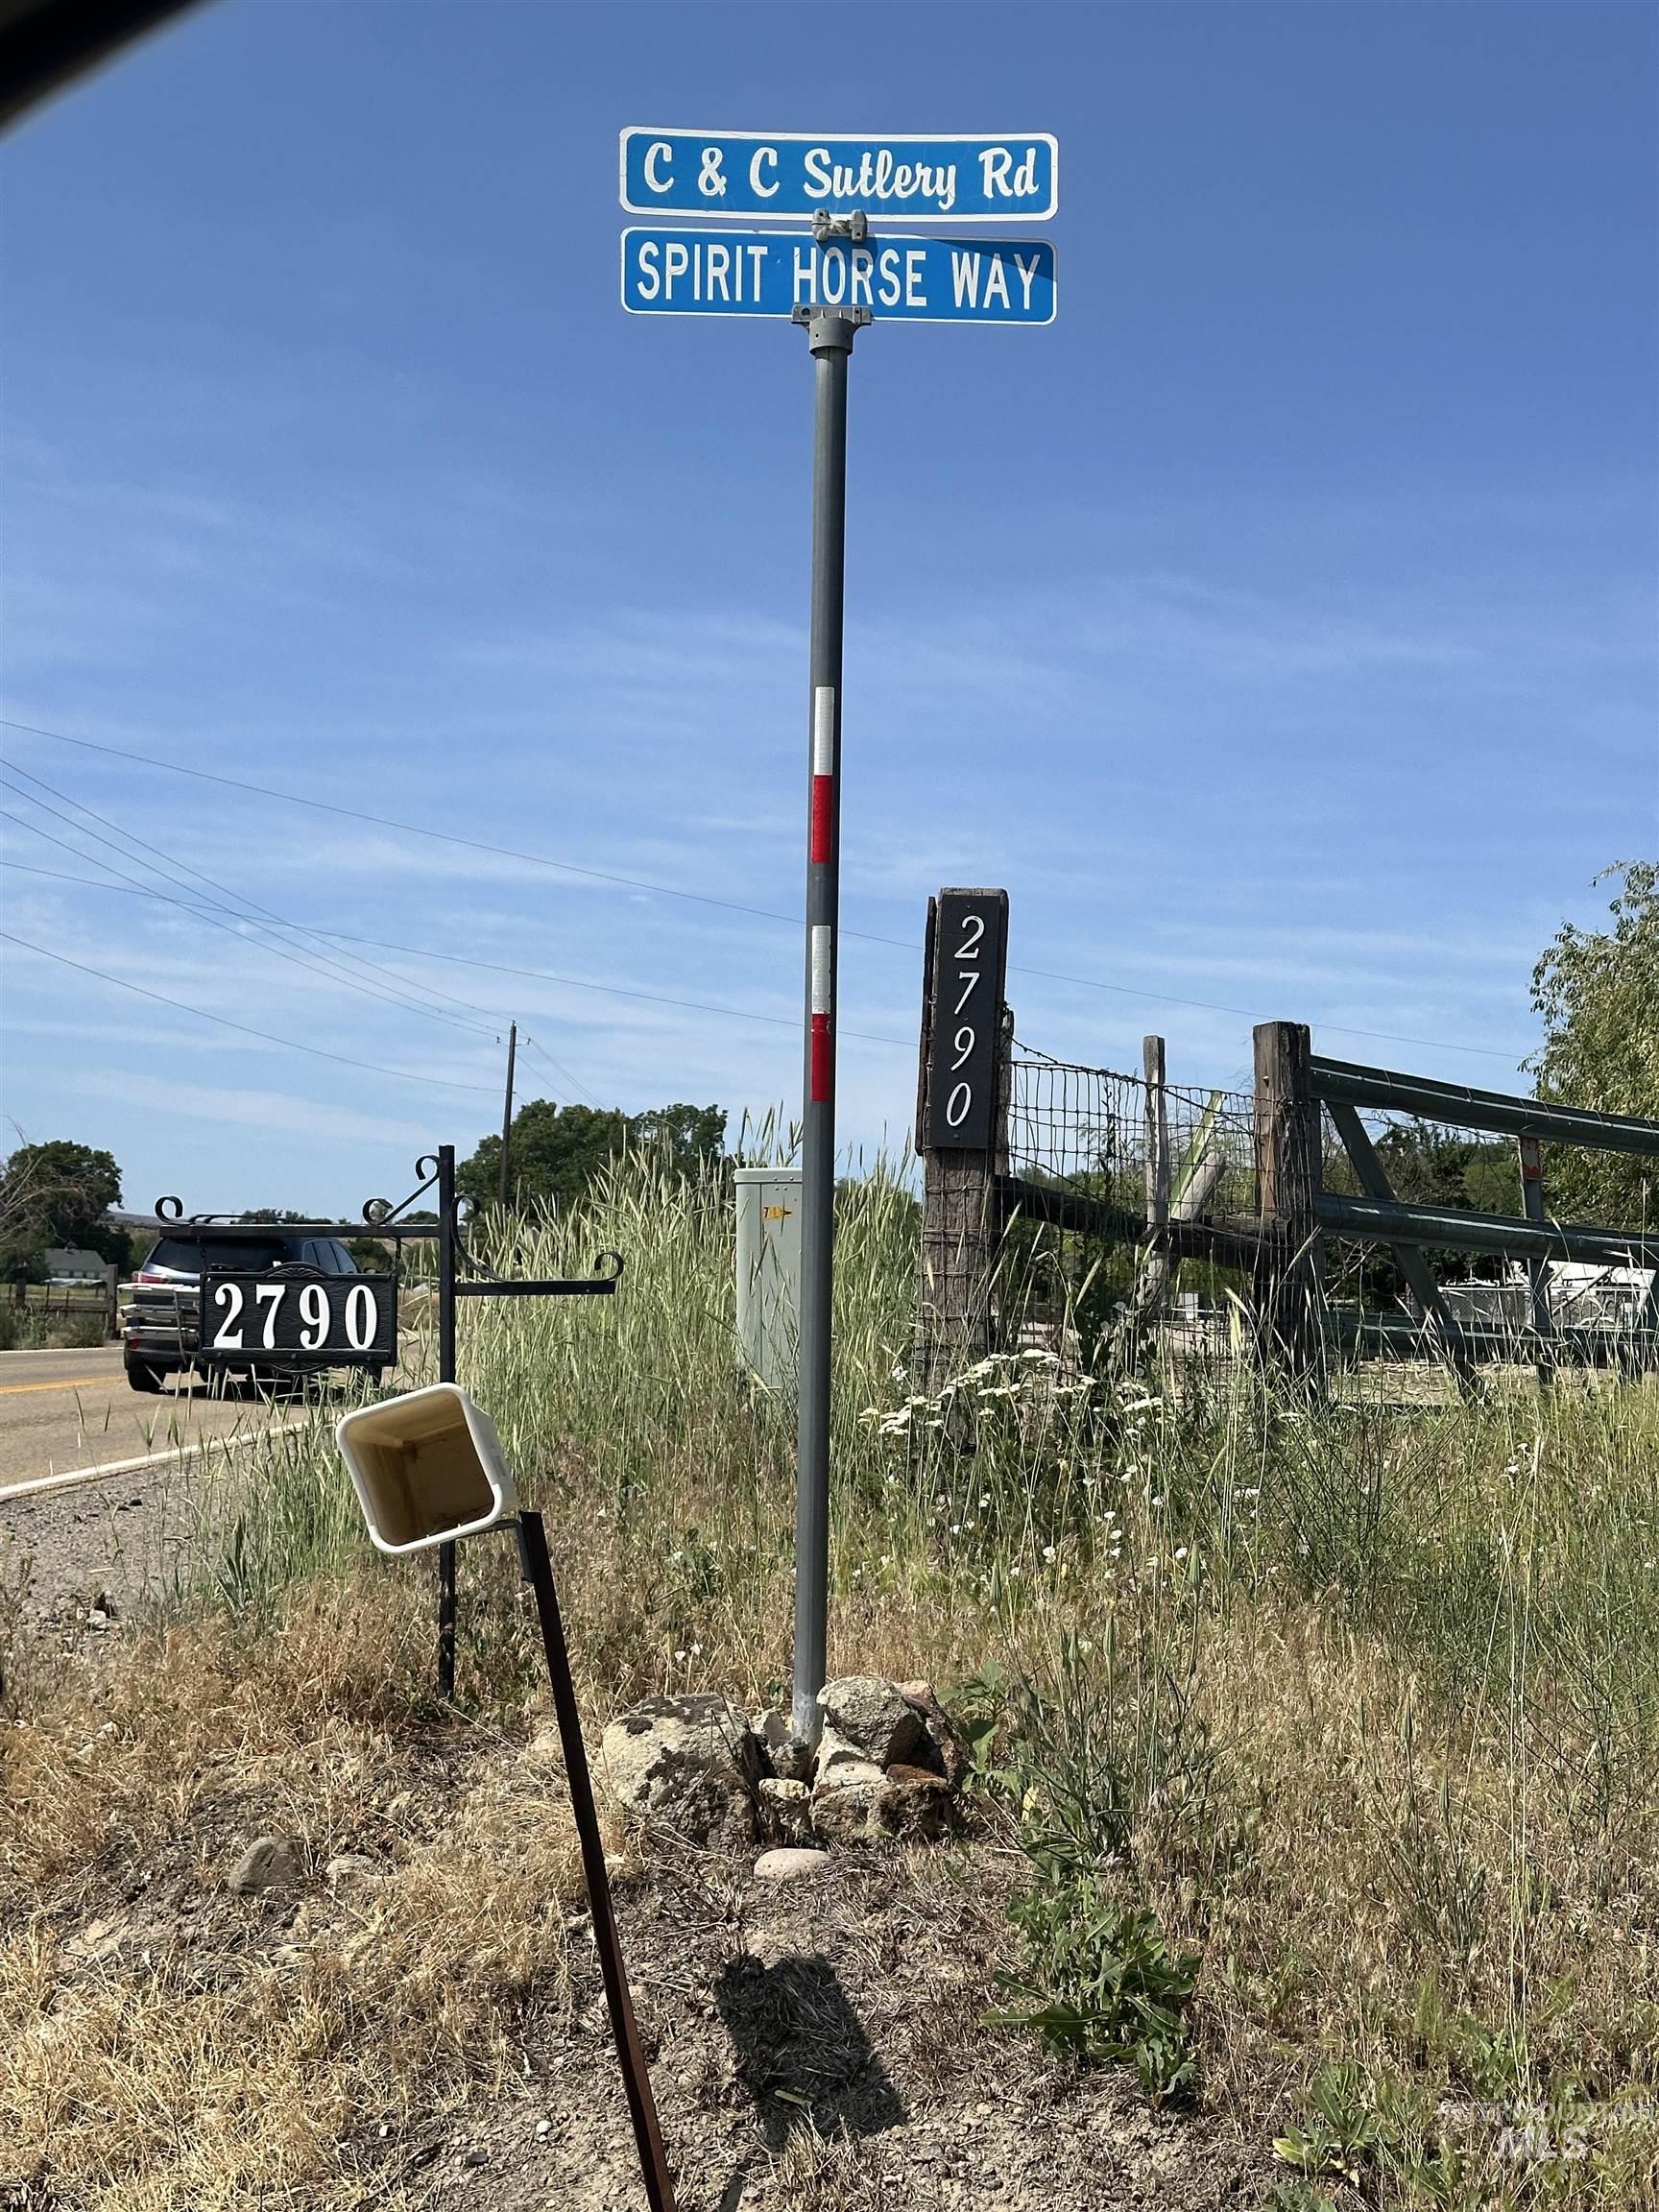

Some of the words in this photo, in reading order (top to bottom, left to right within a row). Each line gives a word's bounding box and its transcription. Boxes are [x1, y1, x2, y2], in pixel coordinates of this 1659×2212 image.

[644, 142, 674, 193] C
[698, 147, 727, 197] &
[750, 147, 779, 198] C
[803, 148, 956, 210] Sutlery
[978, 147, 1039, 200] Rd
[637, 241, 768, 302] SPIRIT
[793, 247, 927, 307] HORSE
[951, 252, 1041, 310] WAY
[946, 915, 985, 1127] 2790
[213, 1283, 377, 1350] 2790
